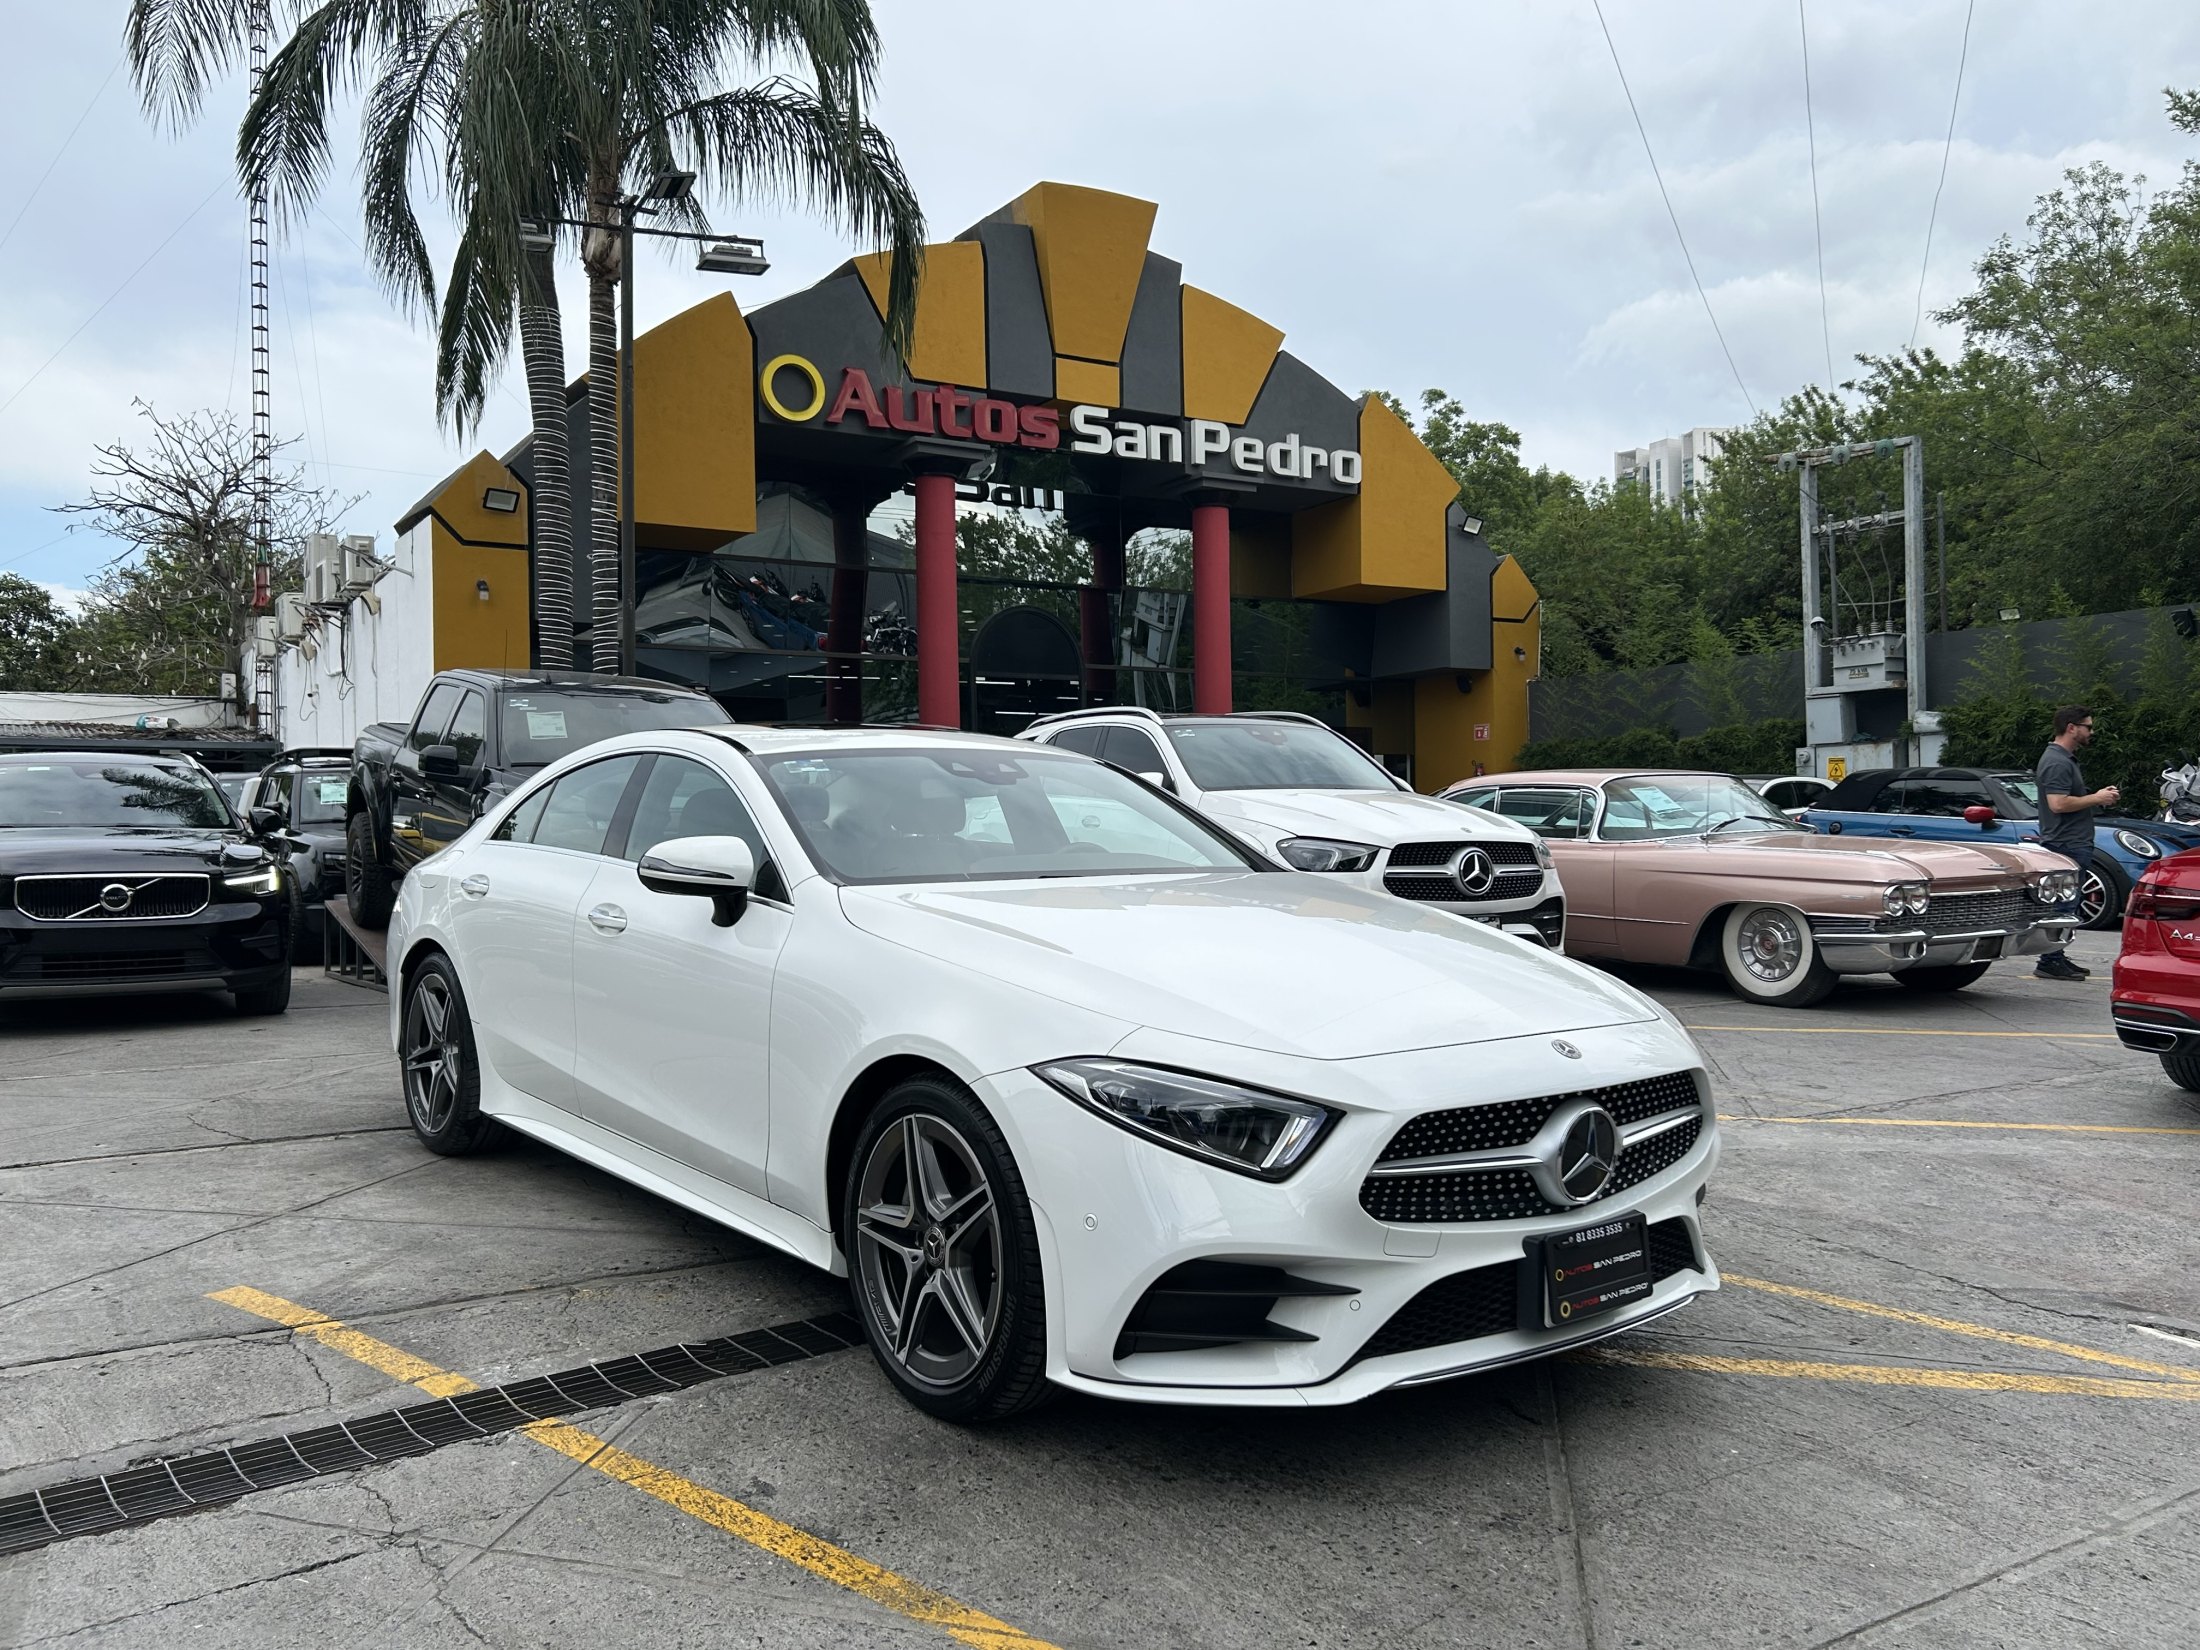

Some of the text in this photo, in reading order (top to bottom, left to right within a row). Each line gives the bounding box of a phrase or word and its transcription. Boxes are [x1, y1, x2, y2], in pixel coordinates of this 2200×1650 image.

[826, 367, 1362, 485] Autos San Pedro
[1575, 1222, 1623, 1243] 81 8335 3535
[1565, 1263, 1594, 1276] AUTOS
[1593, 1258, 1613, 1269] SAN
[1571, 1296, 1600, 1310] AUTOS
[1600, 1290, 1619, 1302] SAN
